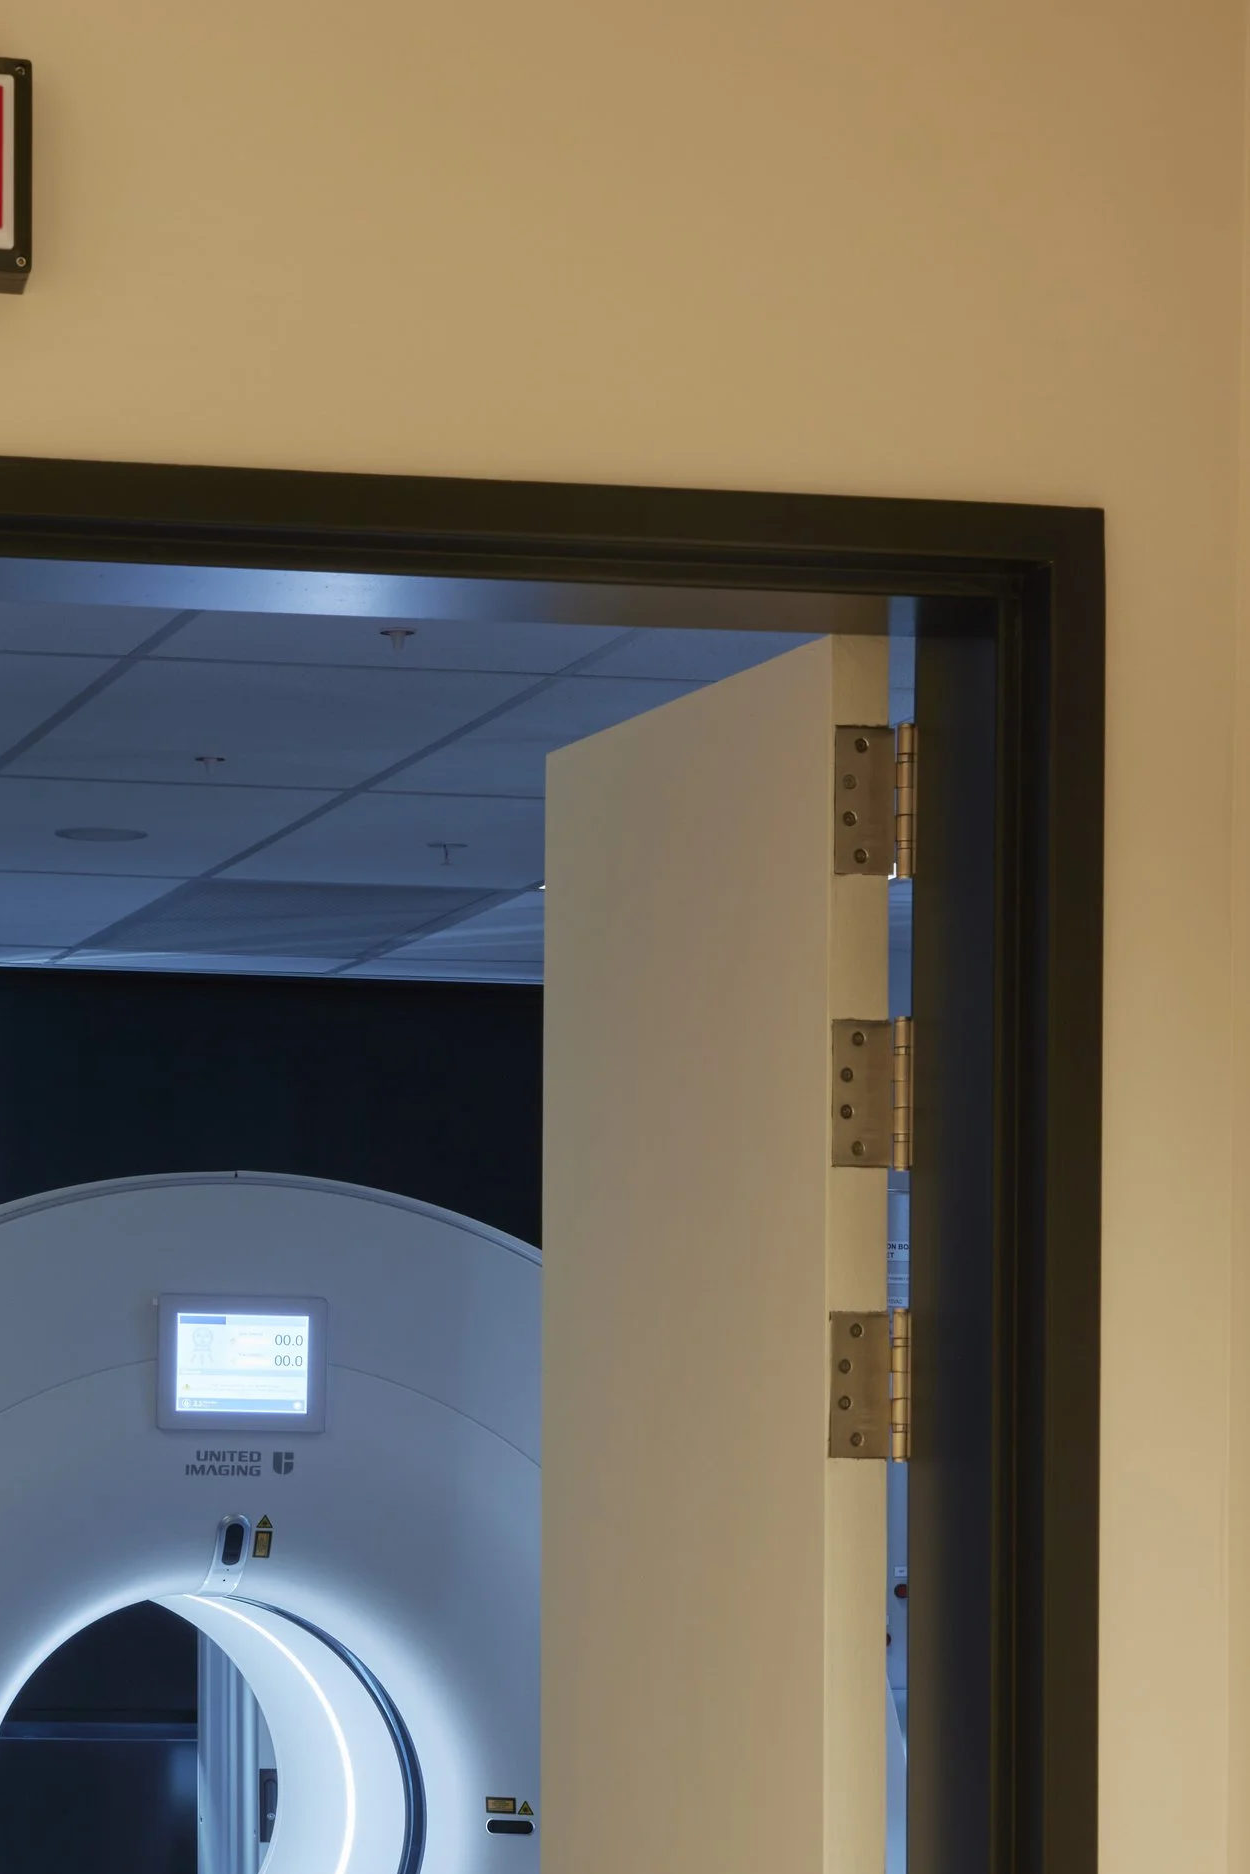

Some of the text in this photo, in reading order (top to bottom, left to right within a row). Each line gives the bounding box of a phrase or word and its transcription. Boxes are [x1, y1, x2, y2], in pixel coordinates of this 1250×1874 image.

[274, 1334, 303, 1346] 00.0
[274, 1355, 303, 1367] 00.0
[196, 1450, 261, 1462] UNITED
[185, 1464, 261, 1477] IMAGING
